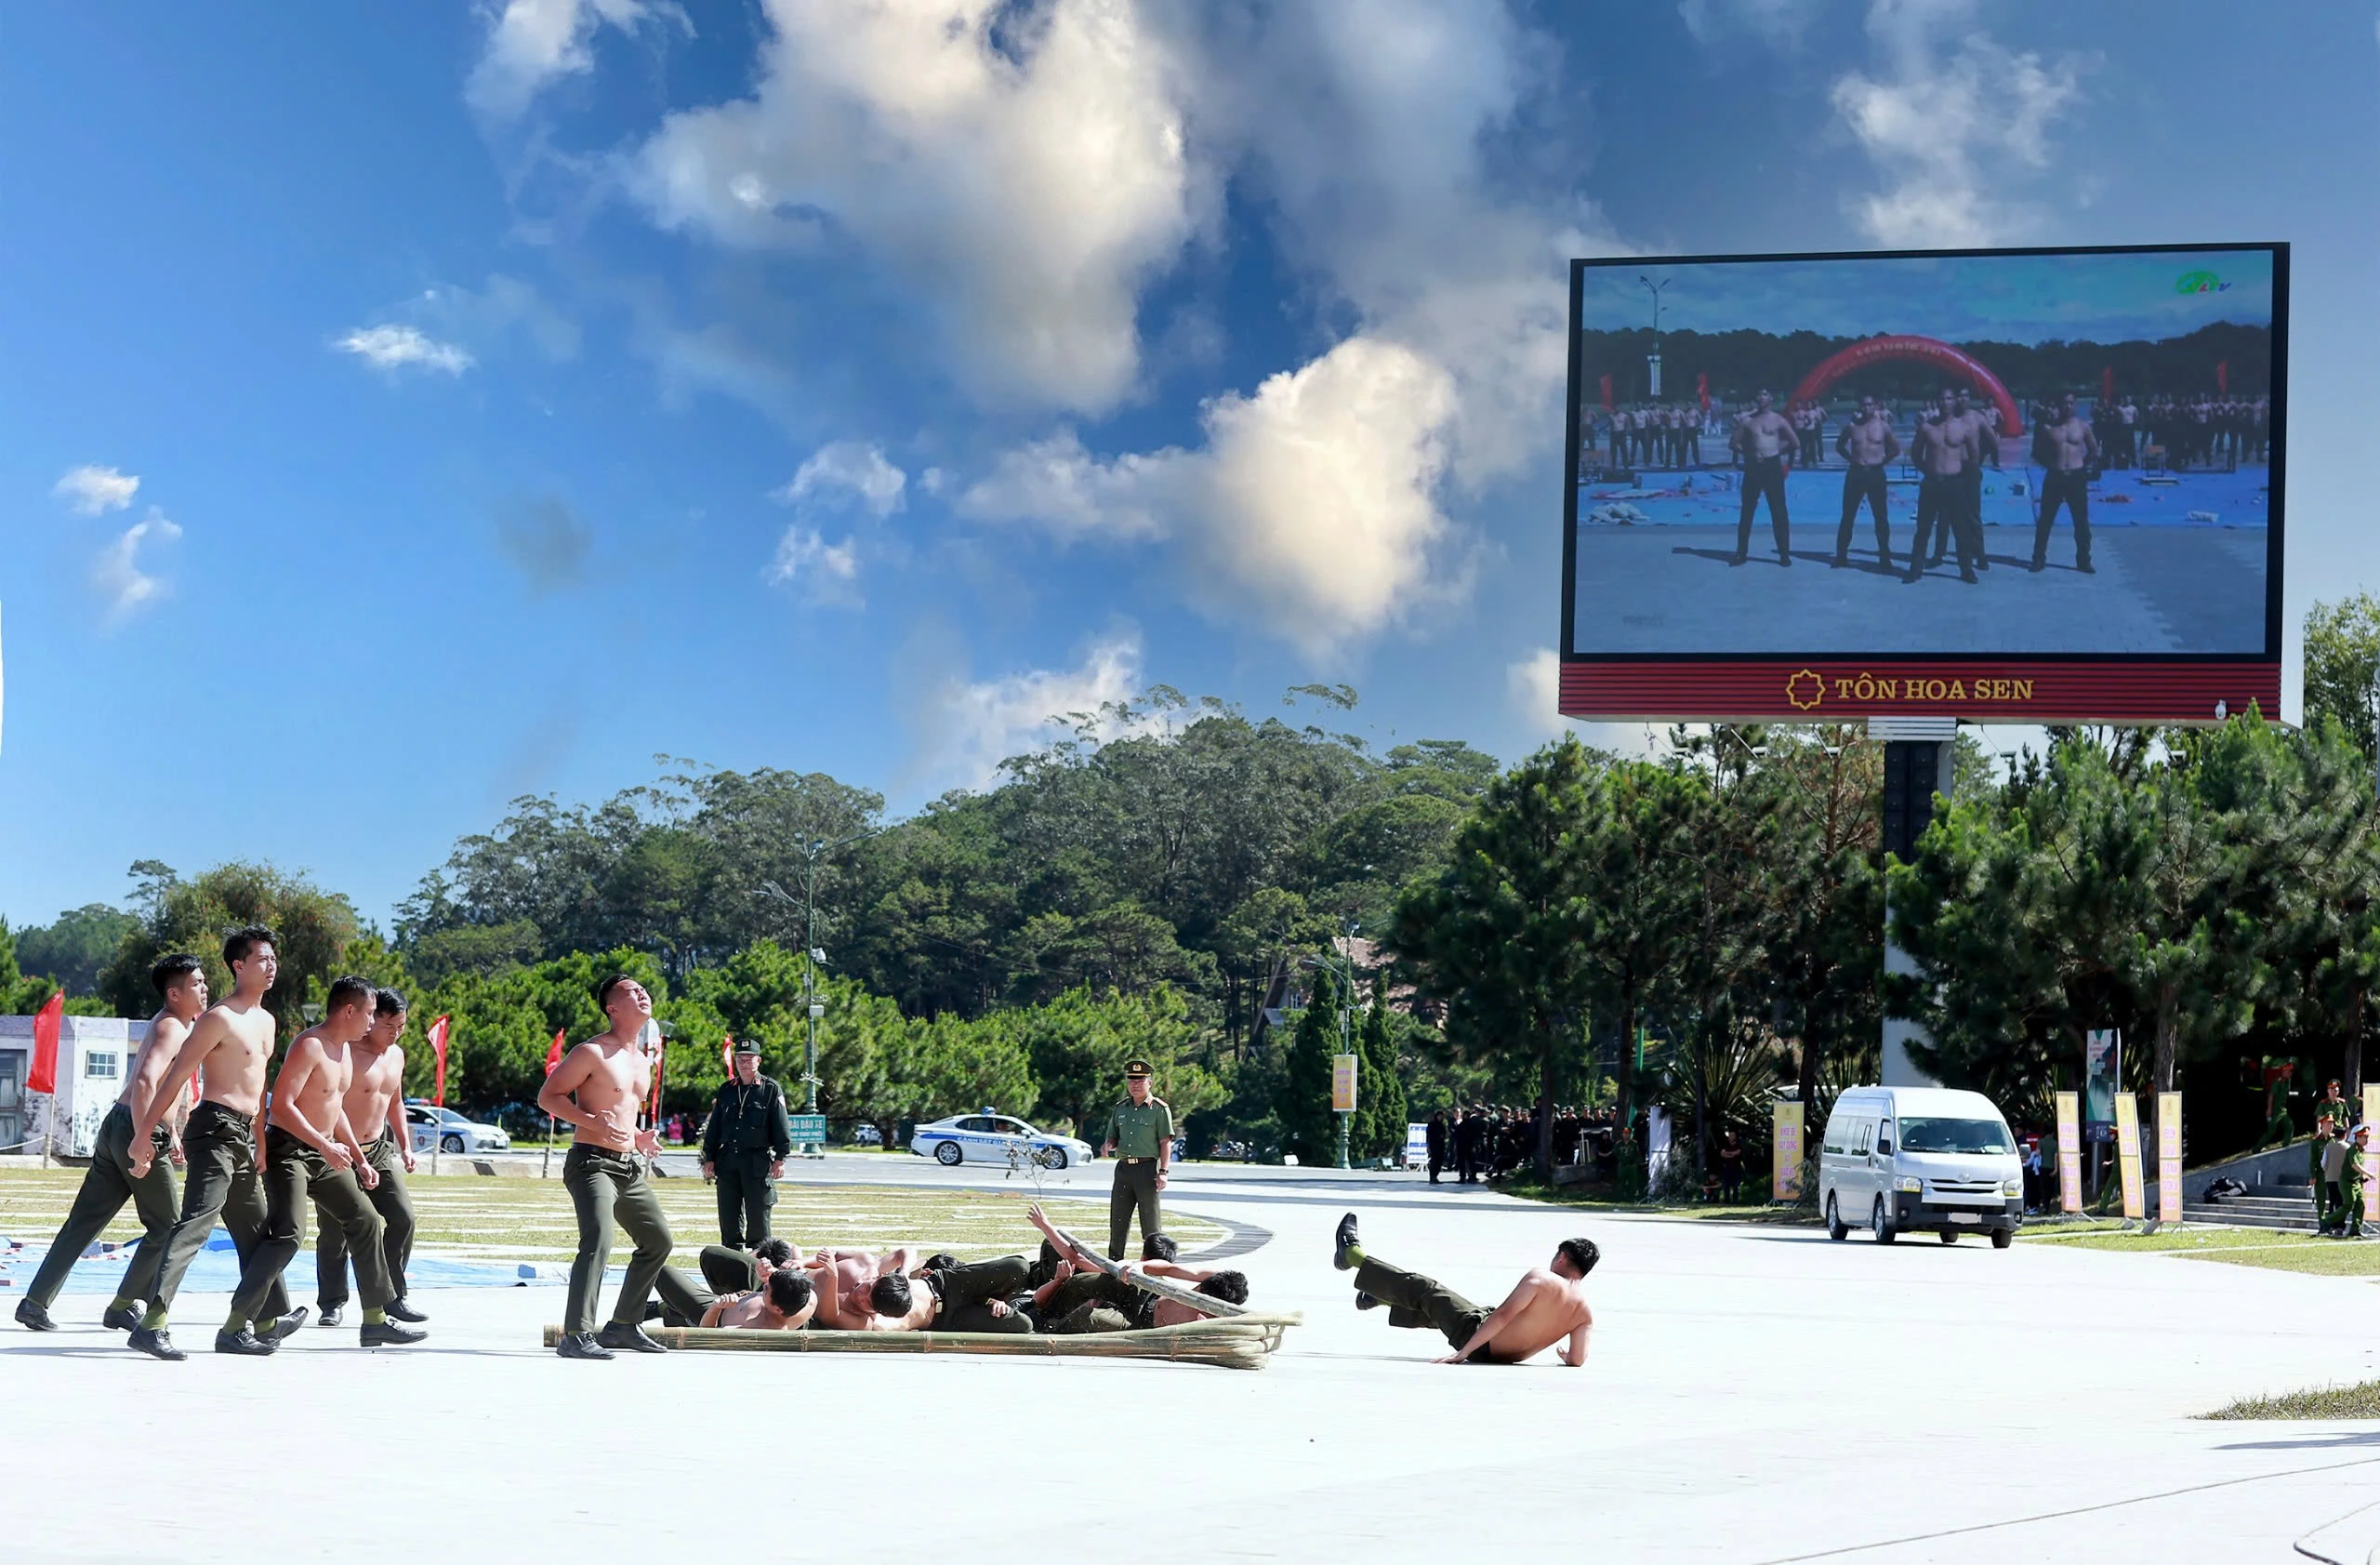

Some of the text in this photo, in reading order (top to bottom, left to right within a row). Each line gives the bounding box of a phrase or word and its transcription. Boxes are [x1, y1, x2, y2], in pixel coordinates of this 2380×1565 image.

[1835, 671, 2035, 700] TÔN HOA SEN
